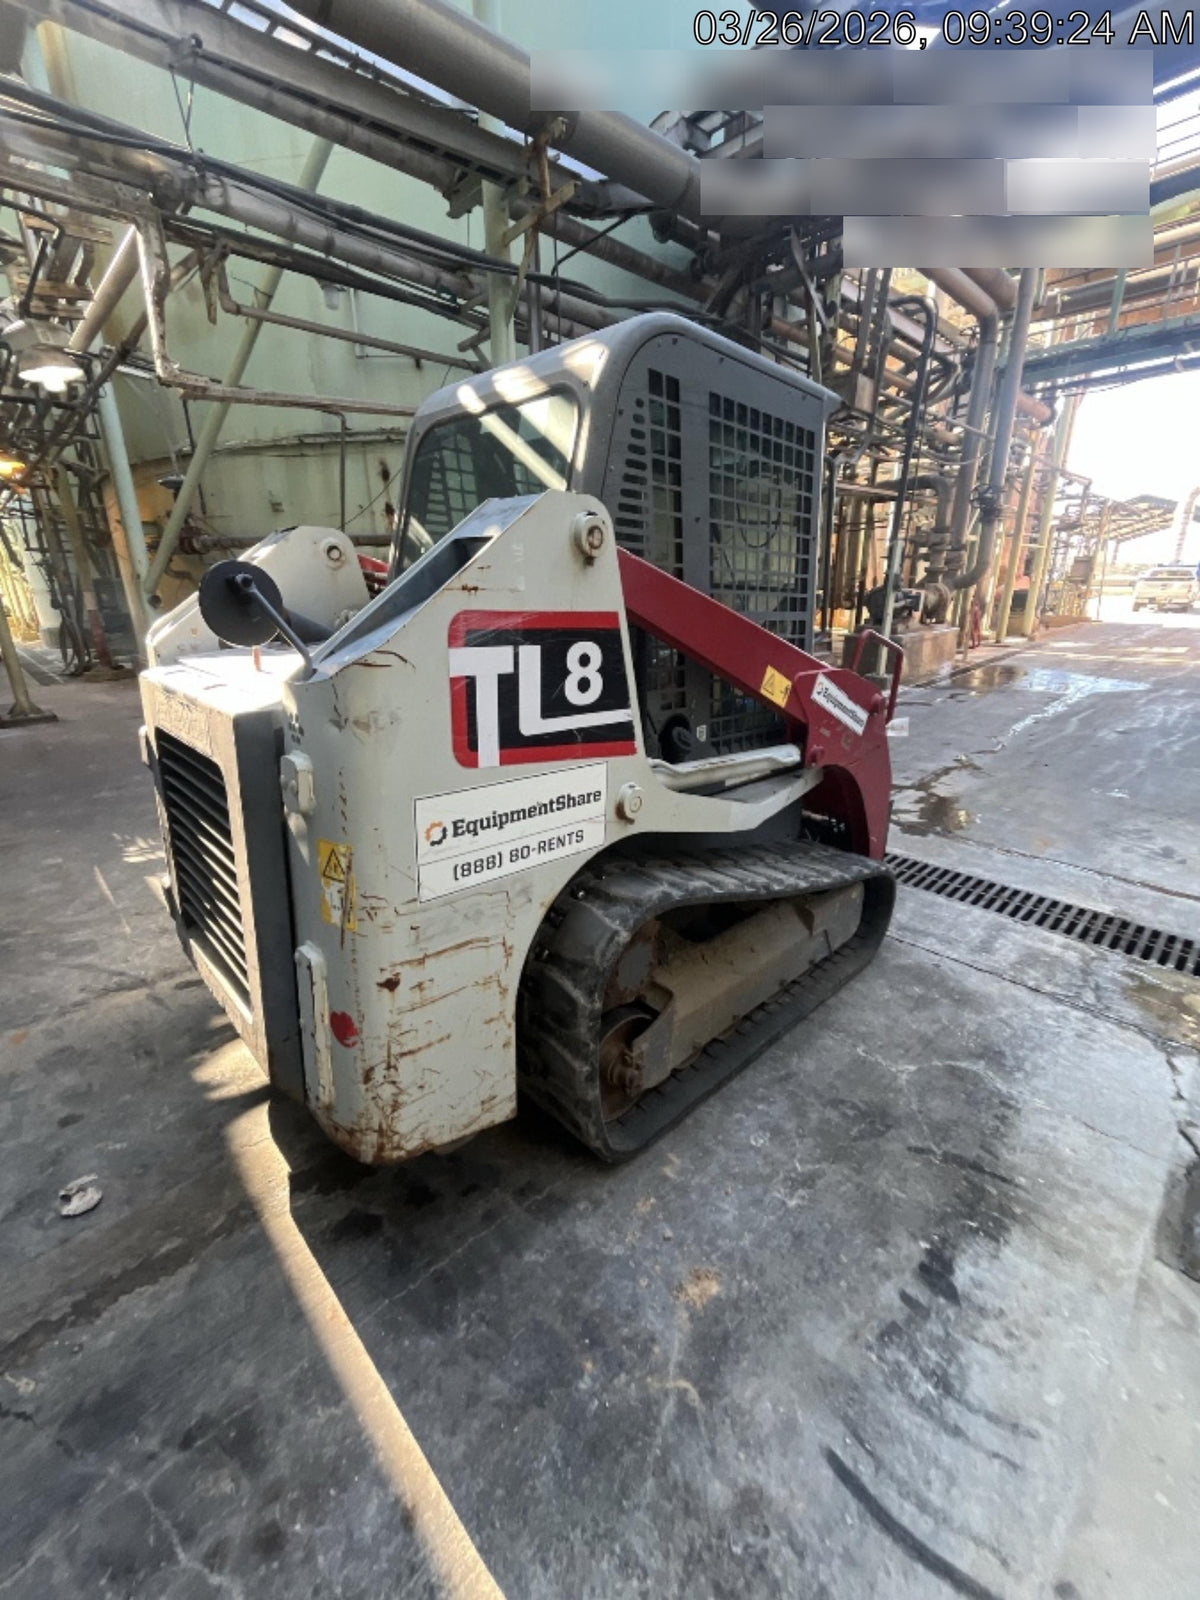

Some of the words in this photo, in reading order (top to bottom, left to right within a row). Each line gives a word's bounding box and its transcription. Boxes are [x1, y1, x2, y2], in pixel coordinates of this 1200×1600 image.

[449, 641, 633, 768] TL8
[452, 790, 602, 838] EquipmentShare
[453, 852, 503, 881] (888)
